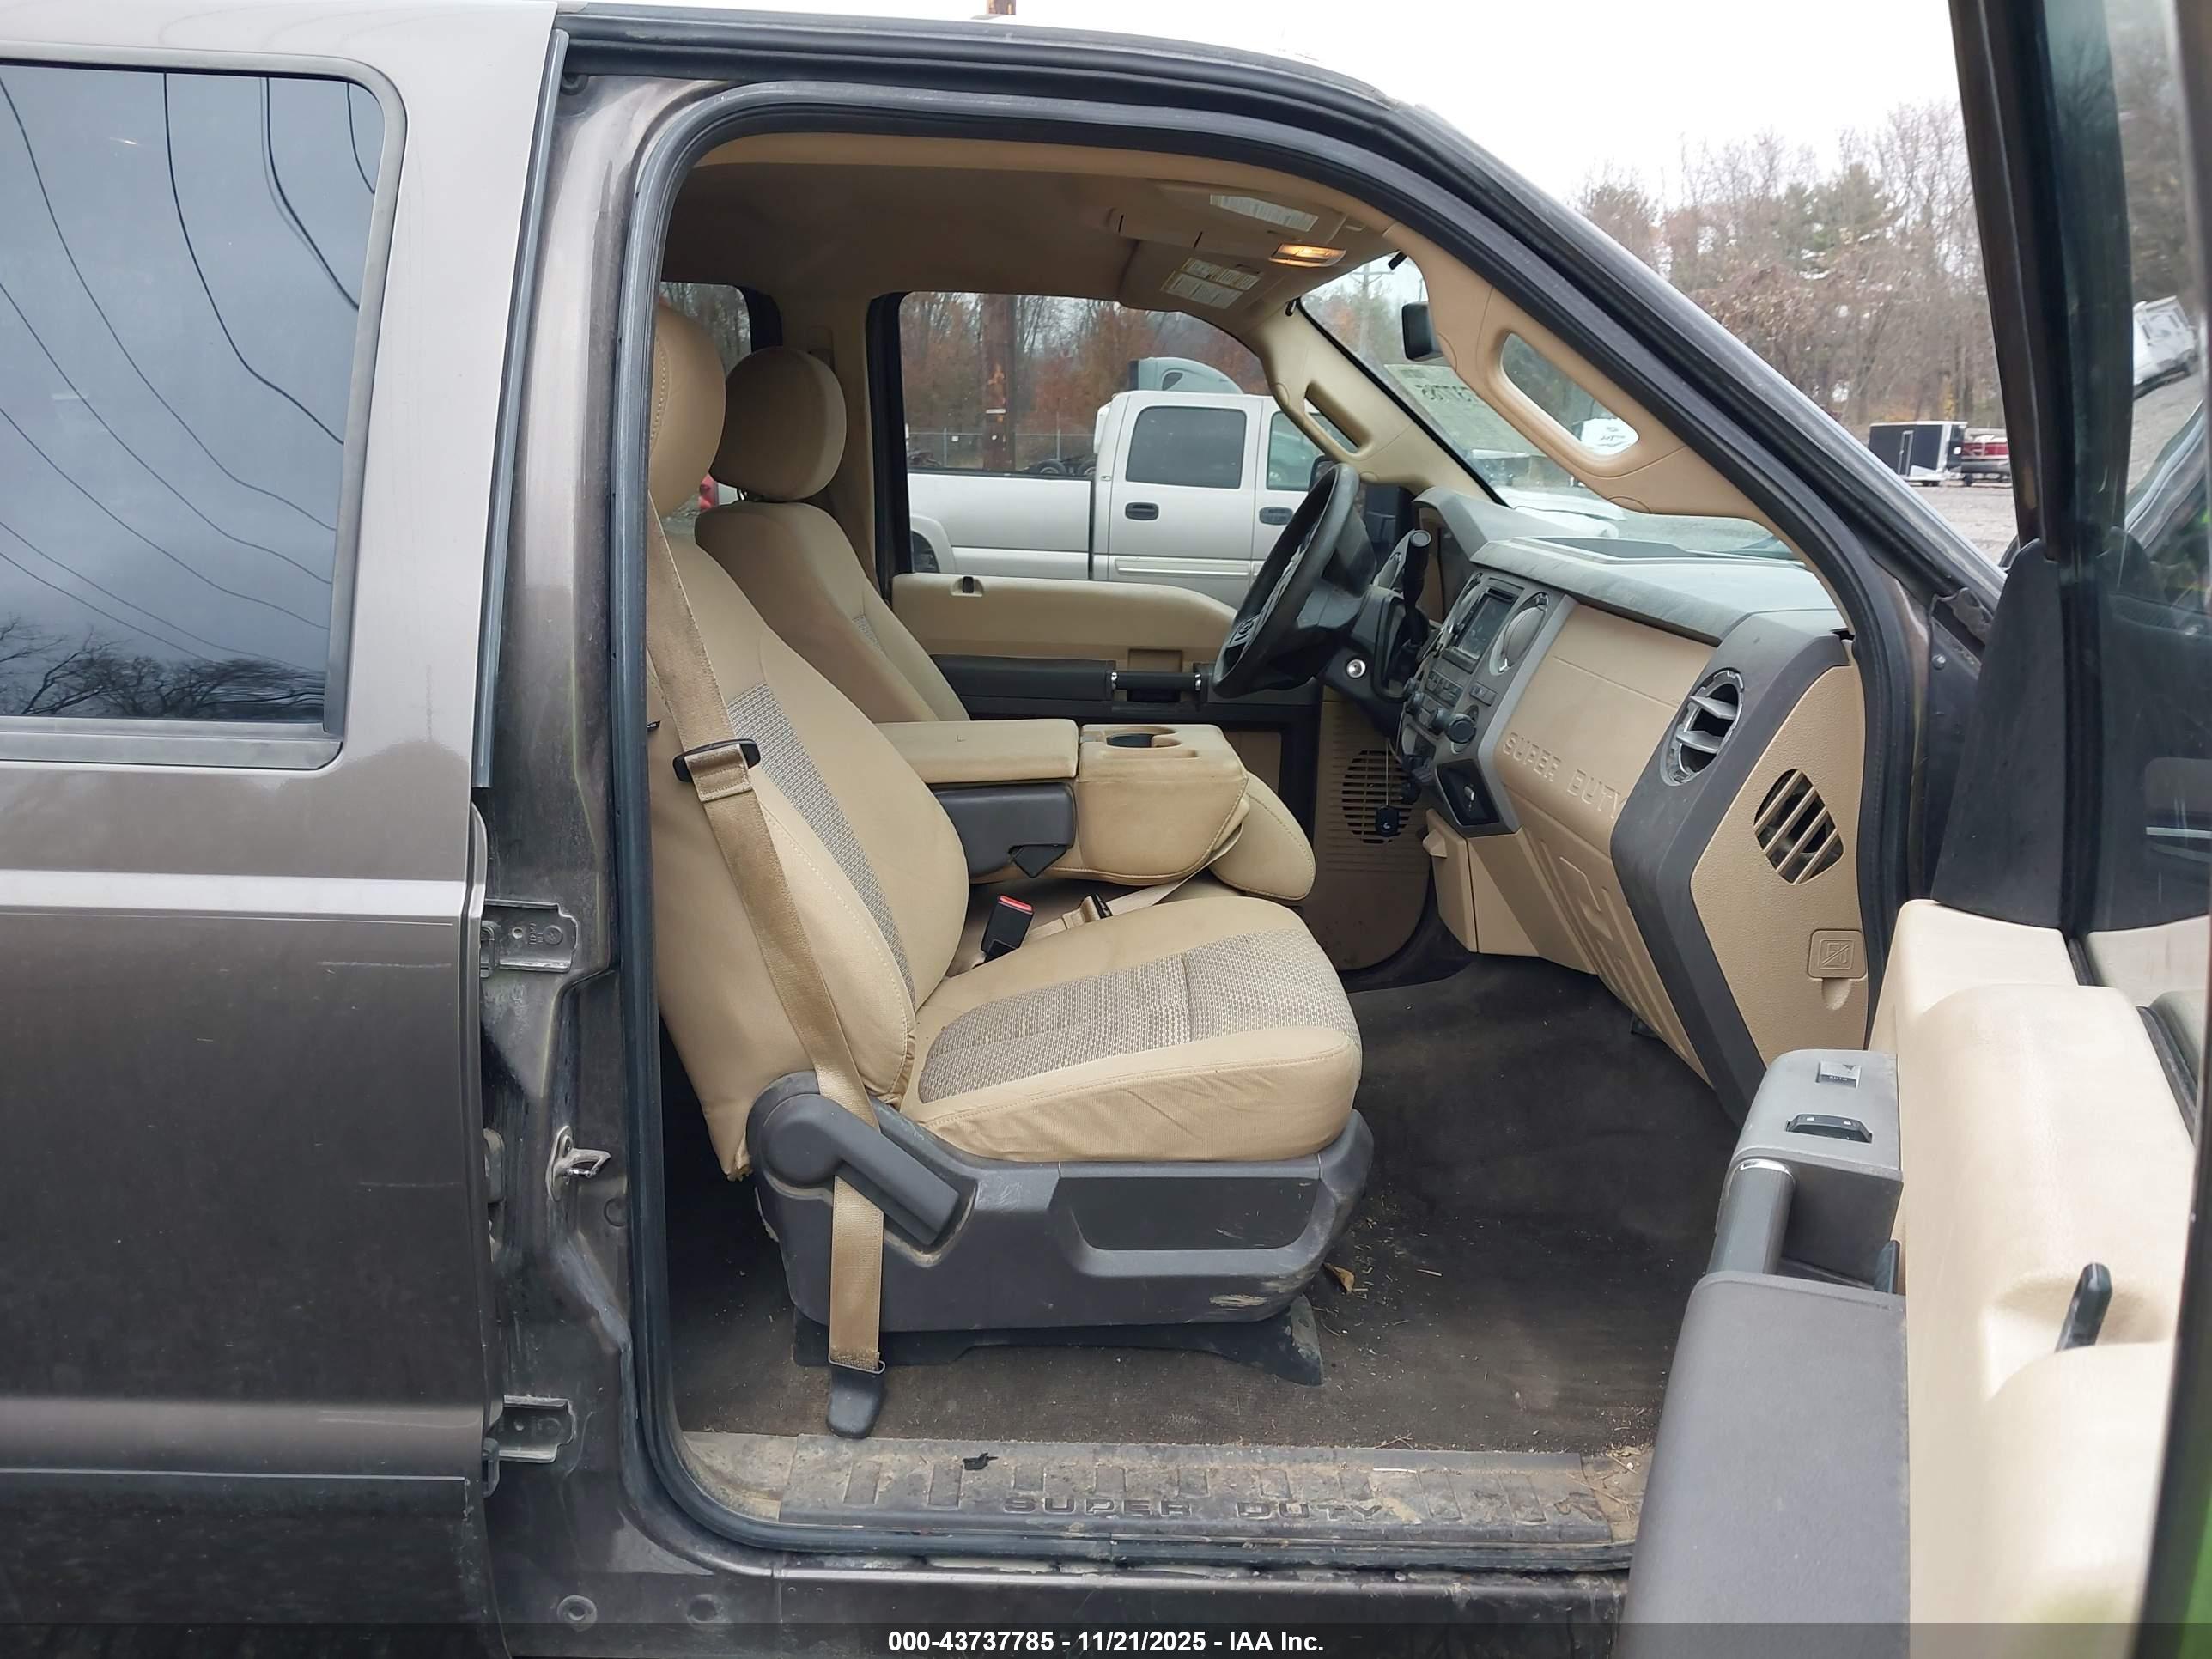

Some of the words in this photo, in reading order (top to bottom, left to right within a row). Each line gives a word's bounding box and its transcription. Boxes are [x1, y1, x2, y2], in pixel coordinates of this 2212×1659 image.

[1503, 732, 1561, 782] SUPER
[1567, 769, 1627, 819] DUTY
[1003, 1497, 1192, 1518] SUPER
[1237, 1501, 1382, 1521] DUTY
